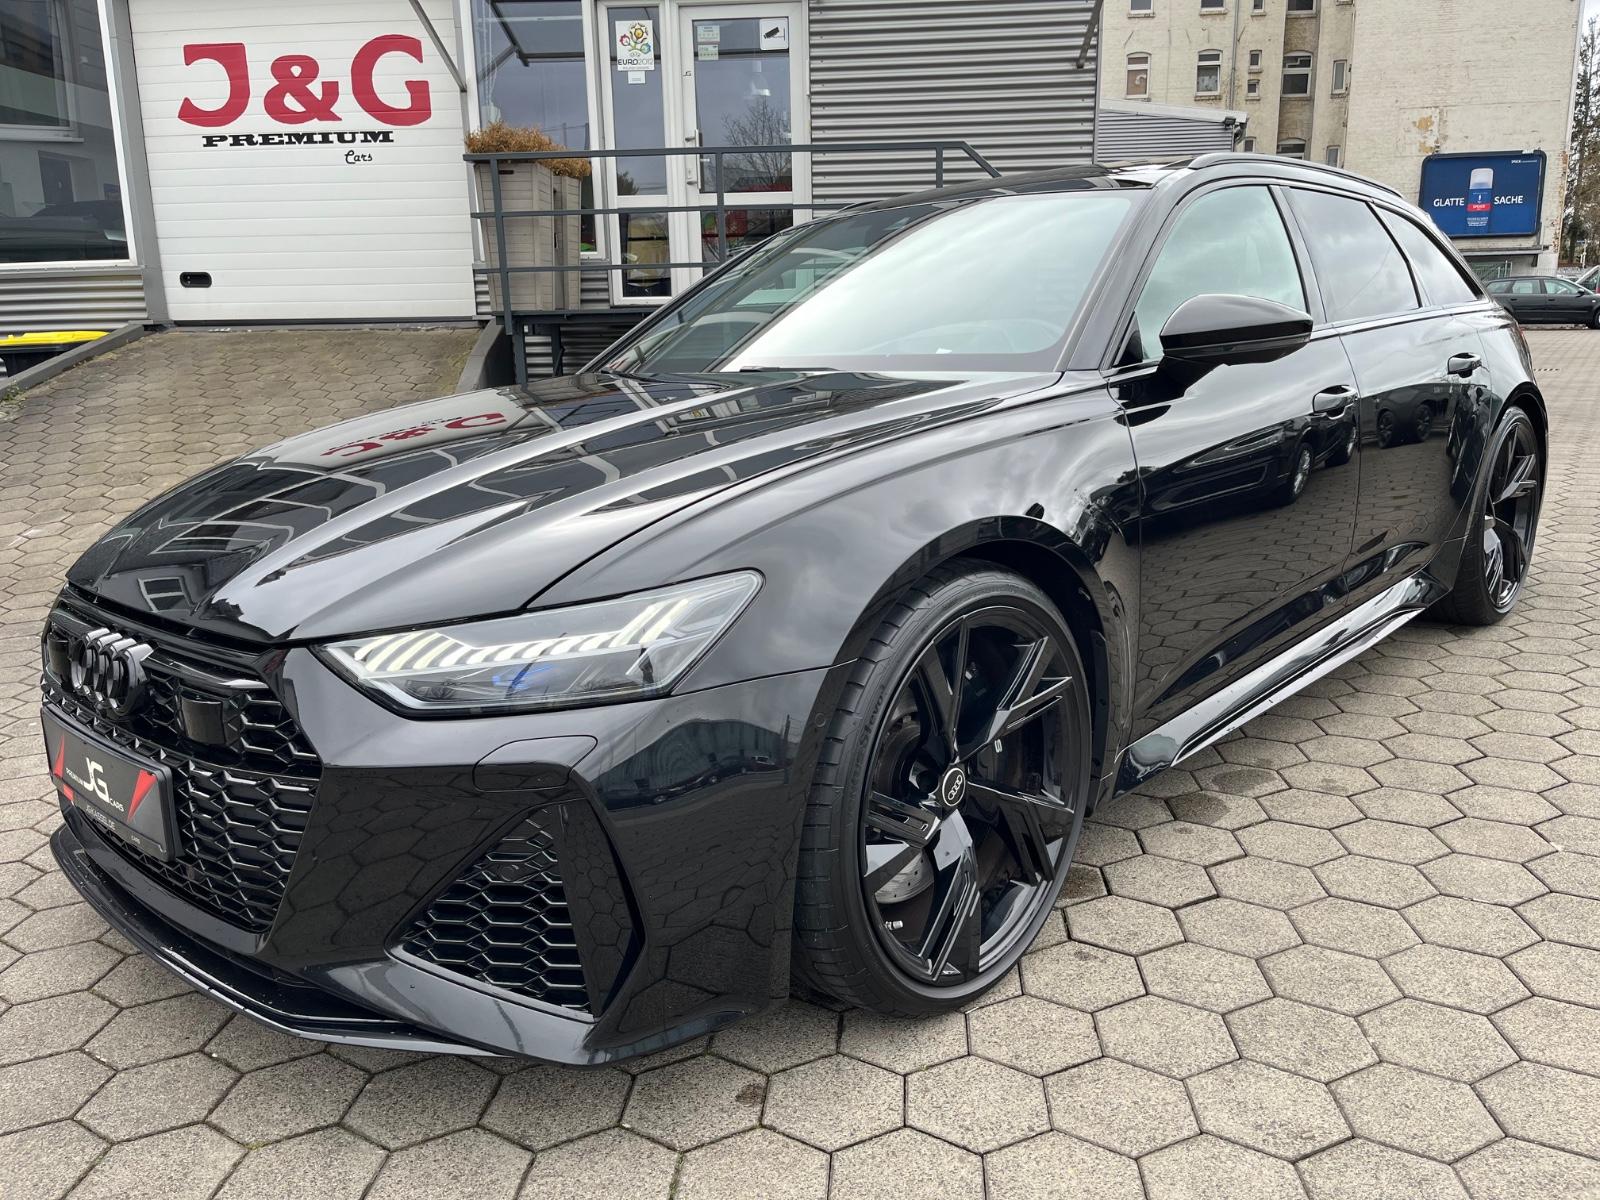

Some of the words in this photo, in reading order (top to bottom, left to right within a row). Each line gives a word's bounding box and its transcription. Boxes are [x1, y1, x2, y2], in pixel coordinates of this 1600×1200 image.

[202, 131, 394, 147] PREMIUM
[345, 150, 373, 165] Cars
[1433, 198, 1465, 207] GLATTE
[1494, 195, 1524, 205] SACHE
